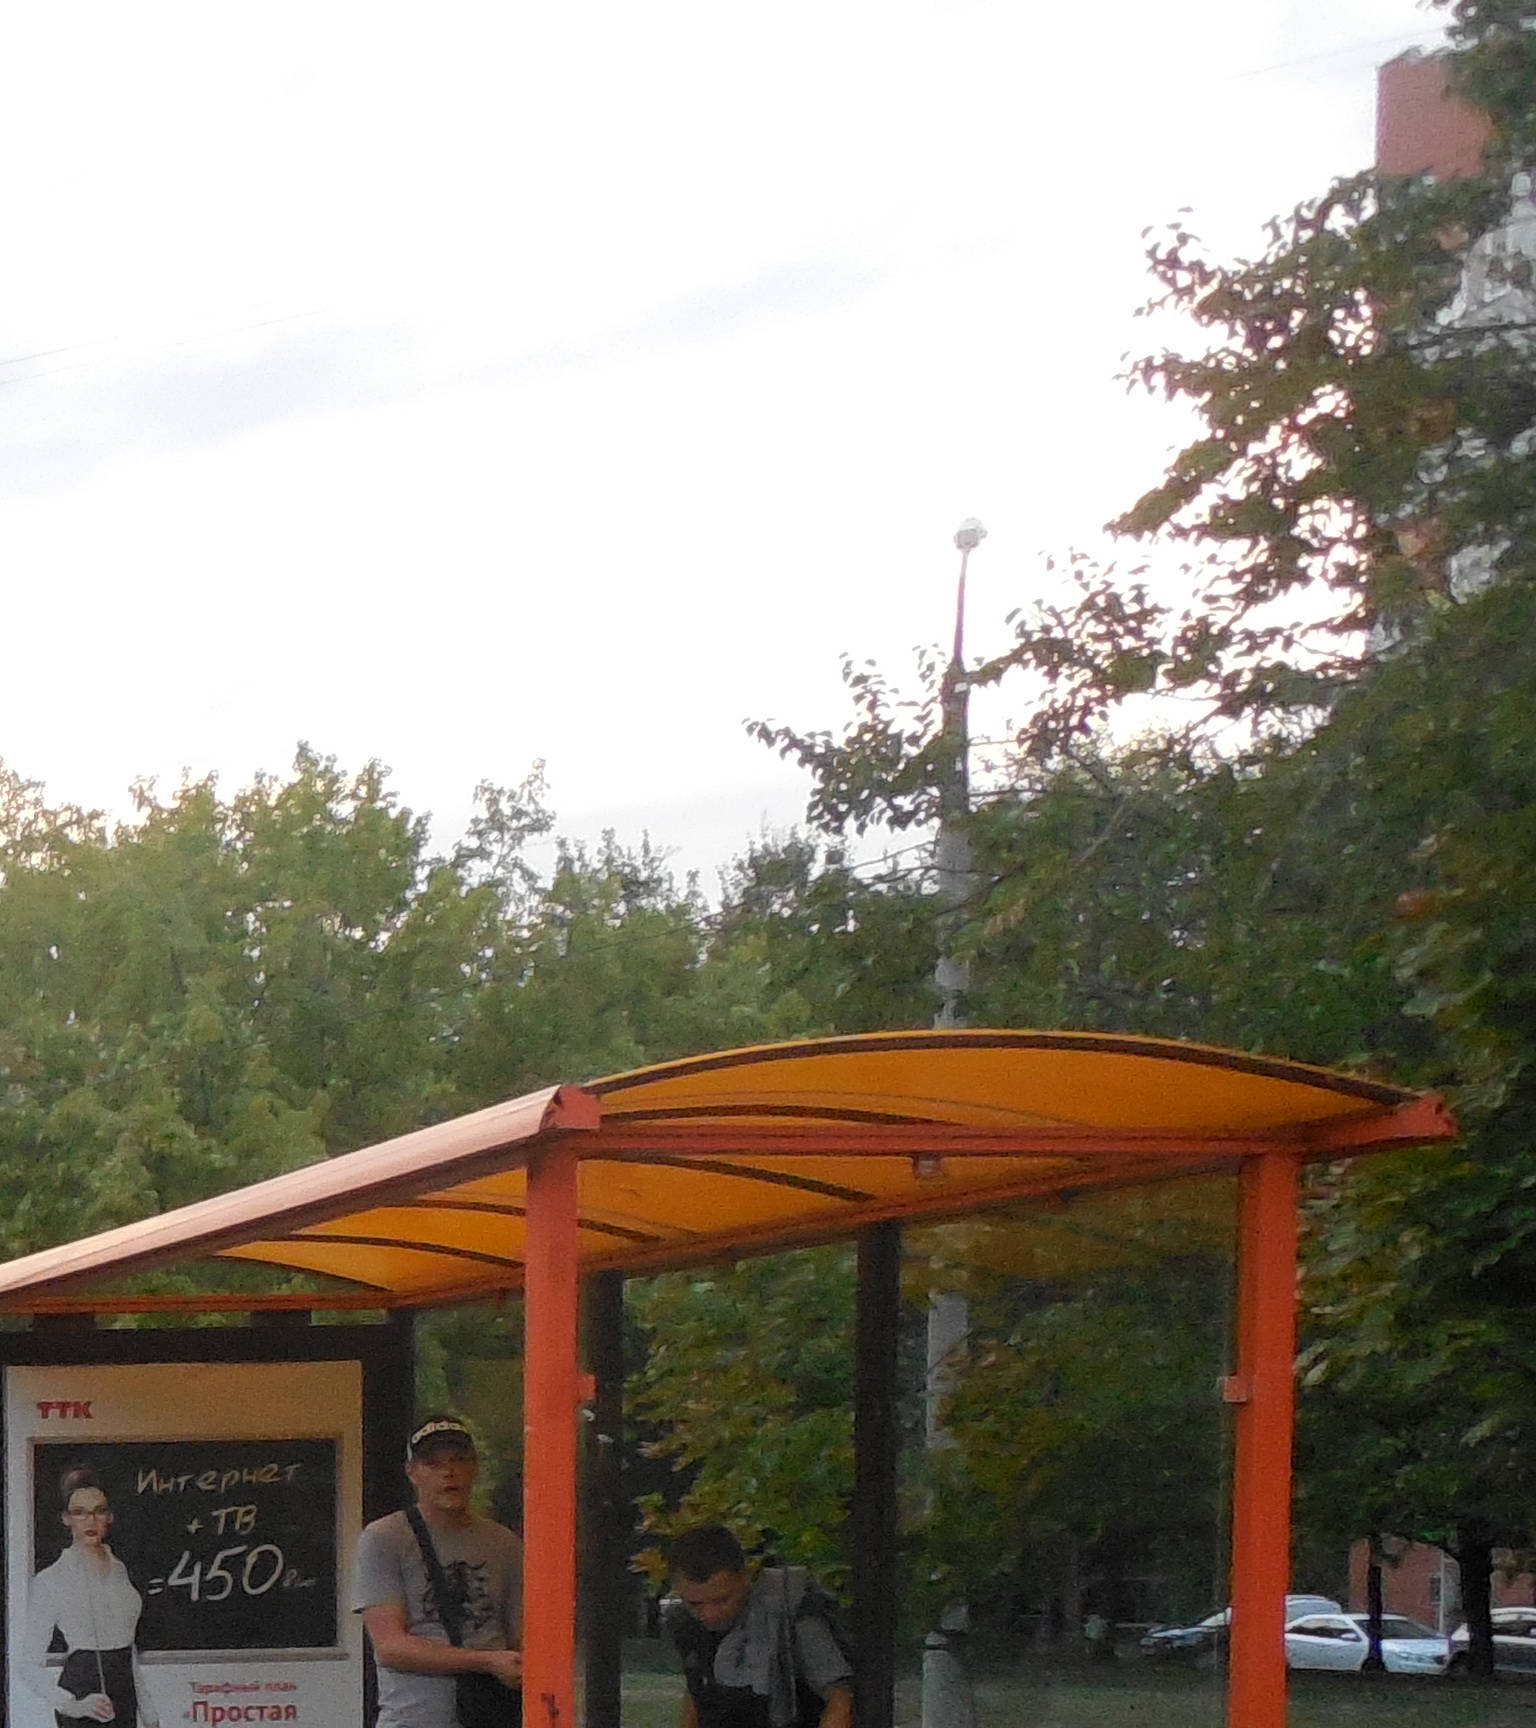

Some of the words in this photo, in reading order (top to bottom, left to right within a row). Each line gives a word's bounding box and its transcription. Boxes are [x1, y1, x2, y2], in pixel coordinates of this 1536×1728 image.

[36, 1401, 93, 1419] ТТК
[136, 1463, 303, 1494] Интернет
[211, 1504, 258, 1535] ТВ
